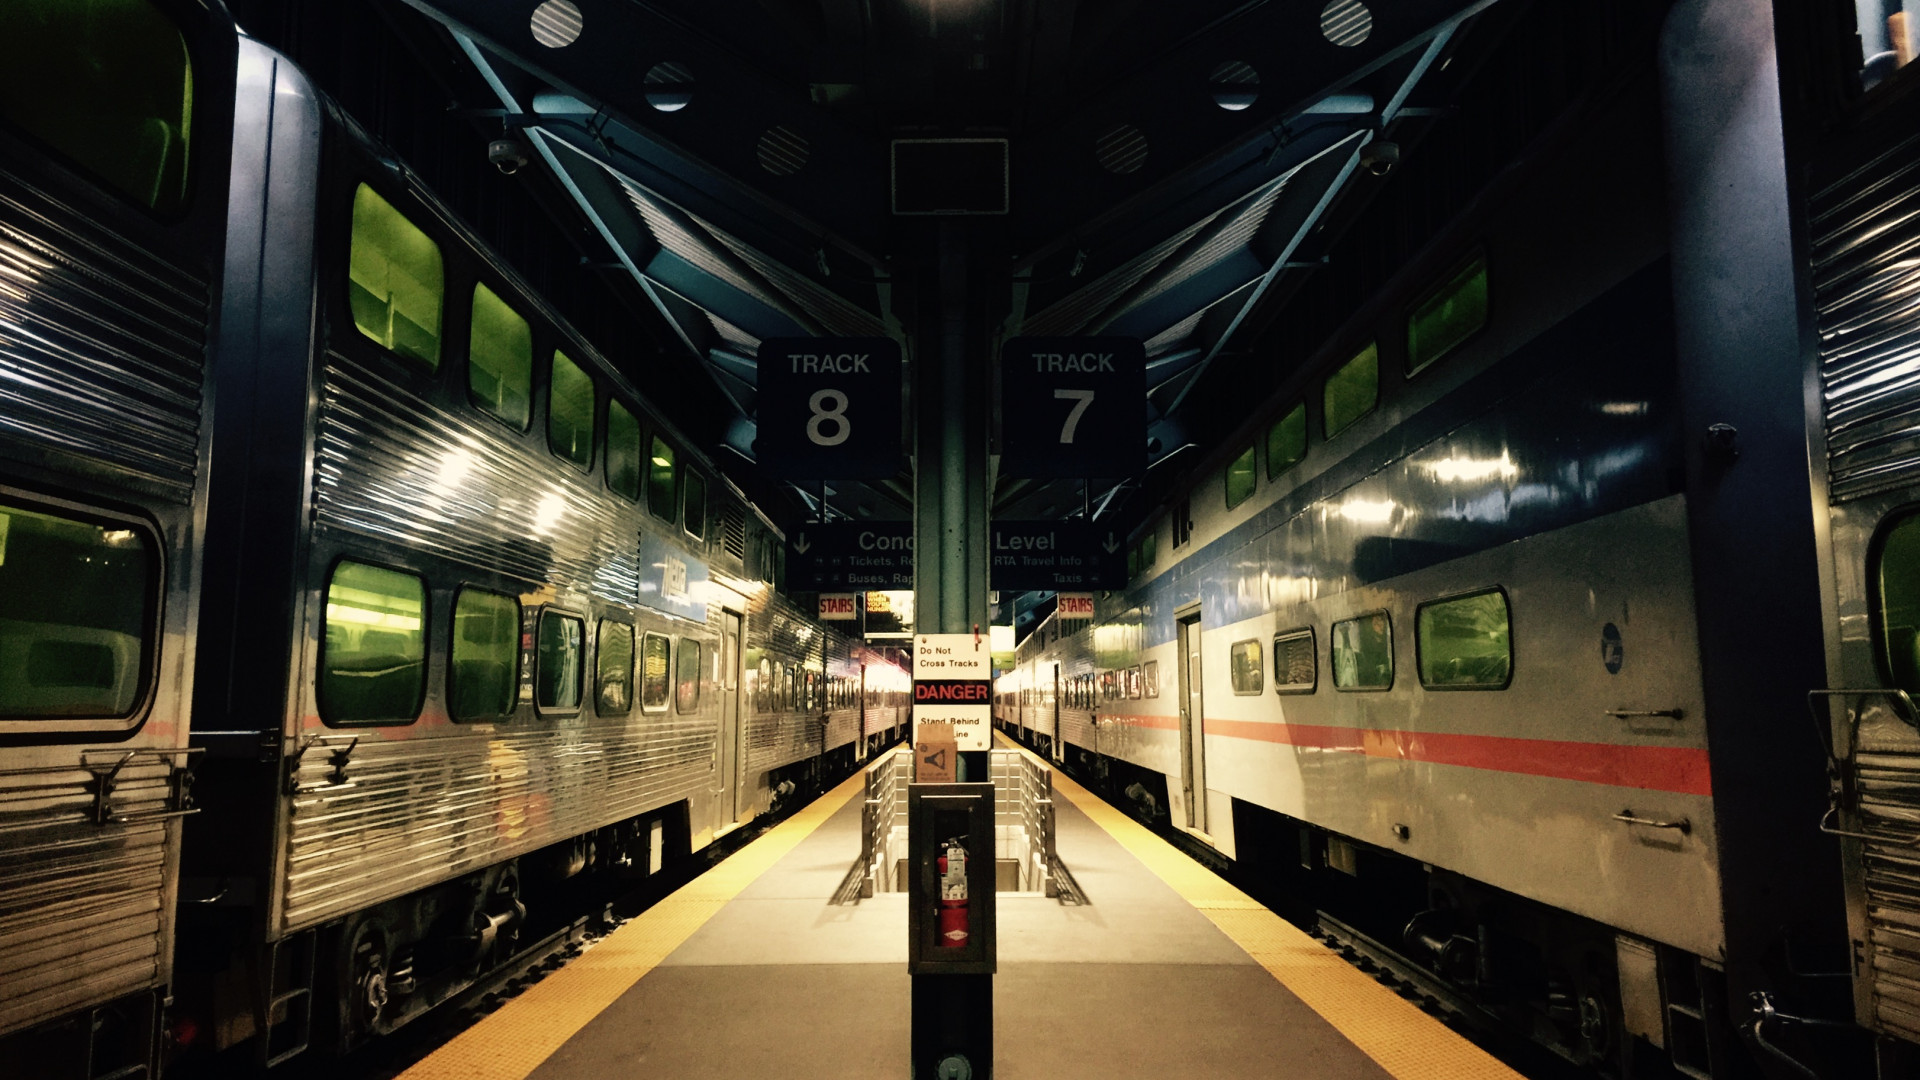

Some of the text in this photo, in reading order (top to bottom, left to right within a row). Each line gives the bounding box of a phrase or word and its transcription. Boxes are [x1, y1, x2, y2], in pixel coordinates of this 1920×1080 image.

[787, 354, 870, 373] TRACK
[1032, 353, 1115, 372] TRACK
[806, 388, 851, 446] 8
[1053, 388, 1095, 444] 7
[996, 532, 1055, 550] Level
[994, 556, 1016, 566] RTA
[1022, 556, 1055, 566] Travel
[1060, 556, 1082, 566] Info
[848, 573, 888, 584] Buses,
[1053, 573, 1082, 583] Taxis
[820, 598, 853, 613] STAIRS
[1060, 598, 1093, 612] STAIRS
[920, 647, 951, 655] Do Not
[920, 660, 978, 668] Cross Tracks
[916, 684, 988, 700] DANGER
[920, 717, 980, 725] Stand Behind
[953, 730, 969, 738] ine
